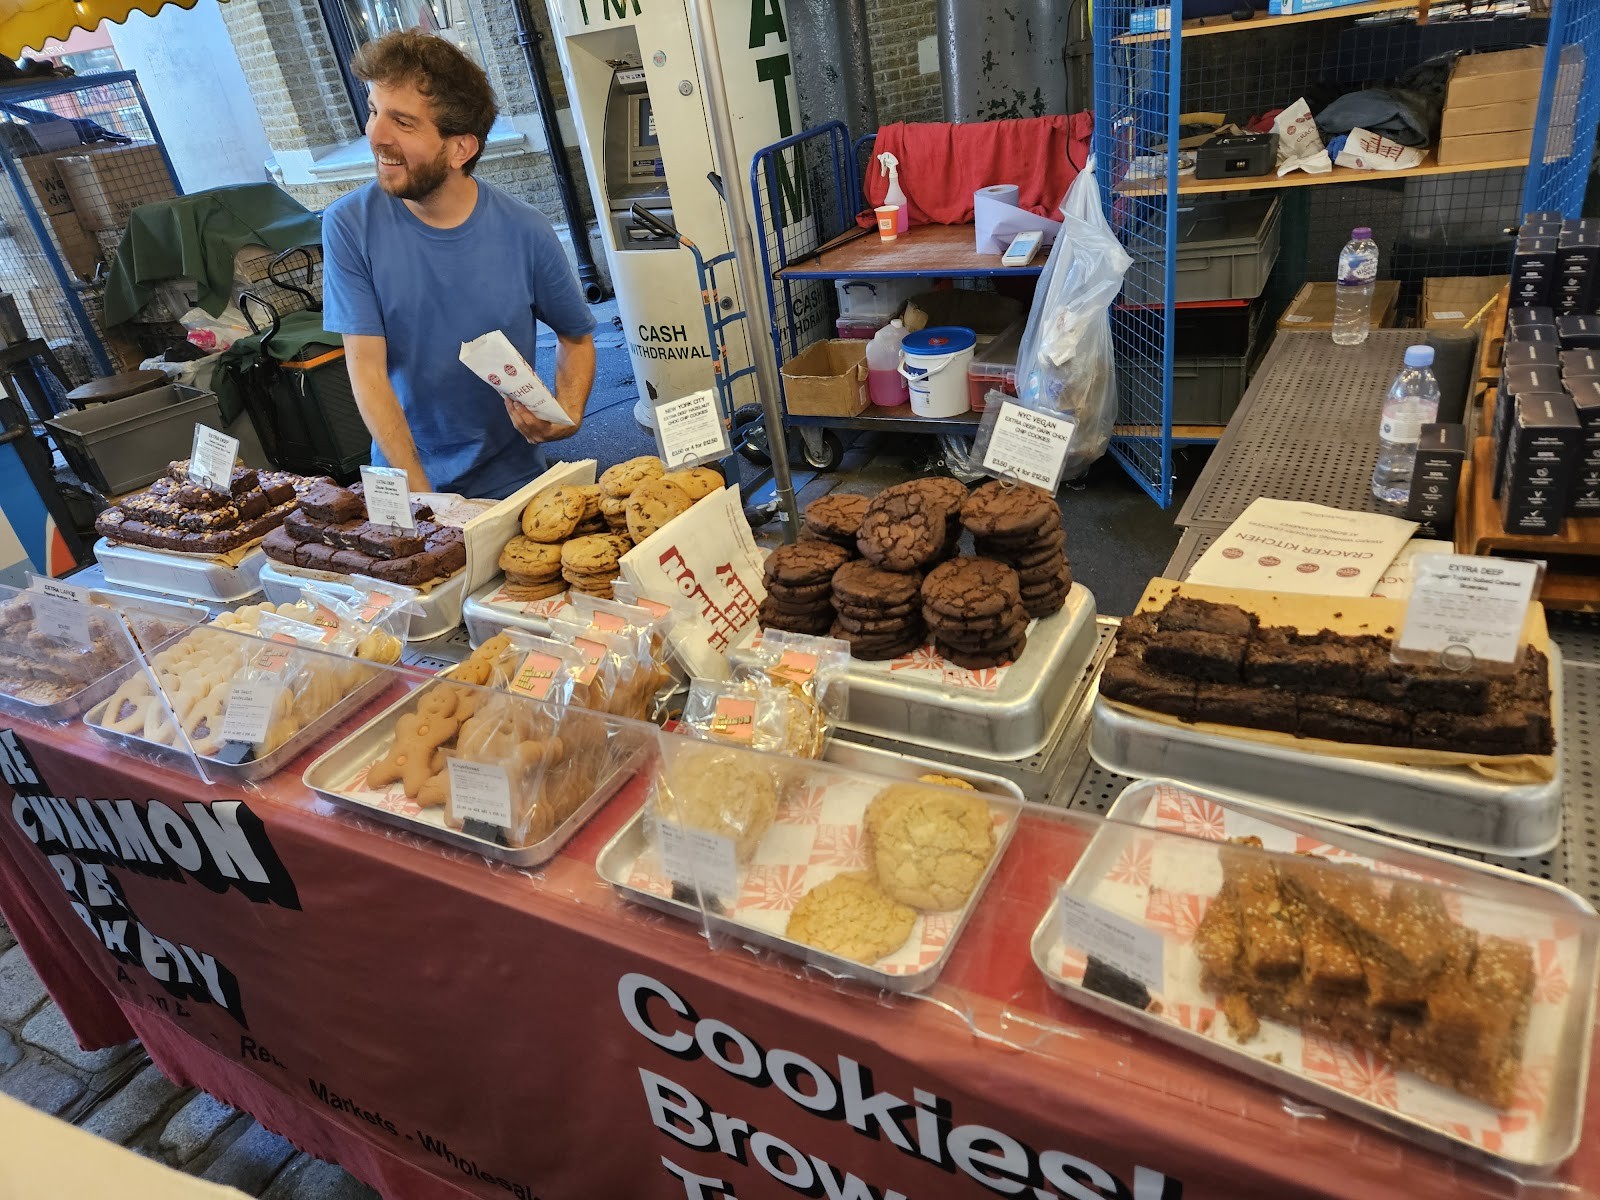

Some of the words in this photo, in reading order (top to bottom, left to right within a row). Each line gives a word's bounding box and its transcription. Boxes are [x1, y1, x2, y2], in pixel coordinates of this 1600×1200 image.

[793, 287, 826, 317] CASH
[639, 324, 687, 342] CASH
[678, 400, 692, 409] YORK
[693, 396, 706, 405] CITY
[663, 413, 677, 421] EXTRA
[677, 409, 688, 417] DEEP
[688, 402, 710, 412] HAZELNUT
[689, 408, 709, 419] COOKIES
[1017, 410, 1033, 421] NYC
[1032, 416, 1057, 429] VEGAN
[1004, 415, 1022, 427] EXTRA
[1022, 421, 1037, 431] DEEP
[1036, 426, 1051, 436] DARK
[1051, 431, 1068, 442] CHOC
[1014, 426, 1027, 434] CHIP
[1027, 431, 1051, 443] COOKIES
[1021, 468, 1031, 476] for
[1235, 531, 1300, 551] KITCHEN
[1302, 546, 1374, 559] CRACKER
[1448, 564, 1478, 575] EXTRA
[1480, 567, 1505, 576] DEEP
[44, 584, 60, 593] EXTRA
[308, 1077, 399, 1137] Markets
